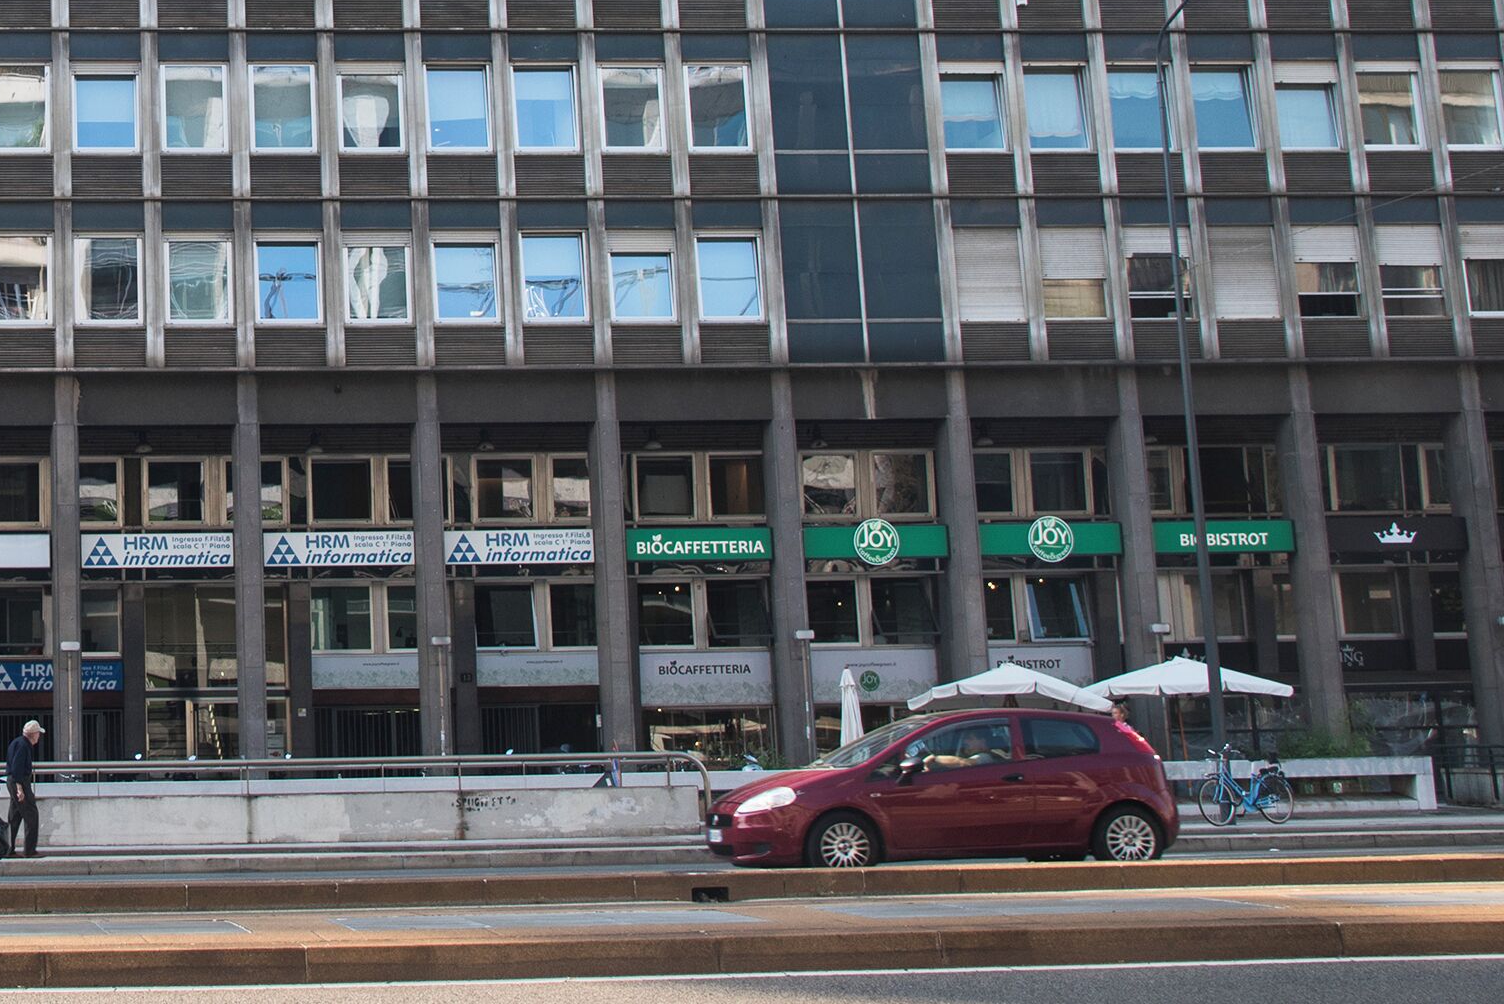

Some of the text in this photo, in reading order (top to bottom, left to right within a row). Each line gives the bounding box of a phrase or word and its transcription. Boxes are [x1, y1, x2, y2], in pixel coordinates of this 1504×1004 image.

[486, 533, 529, 546] HRM
[860, 523, 893, 548] JOY
[1034, 520, 1067, 545] JOY
[1180, 533, 1268, 546] BIBISTROT
[124, 536, 168, 549] HRM
[306, 535, 349, 548] HRM
[636, 540, 764, 554] BIOCAFFETTERIA
[123, 551, 231, 565] informatica
[306, 549, 412, 563] informatica
[486, 547, 591, 561] informatica
[659, 664, 751, 675] BIOCAFFETTERIA
